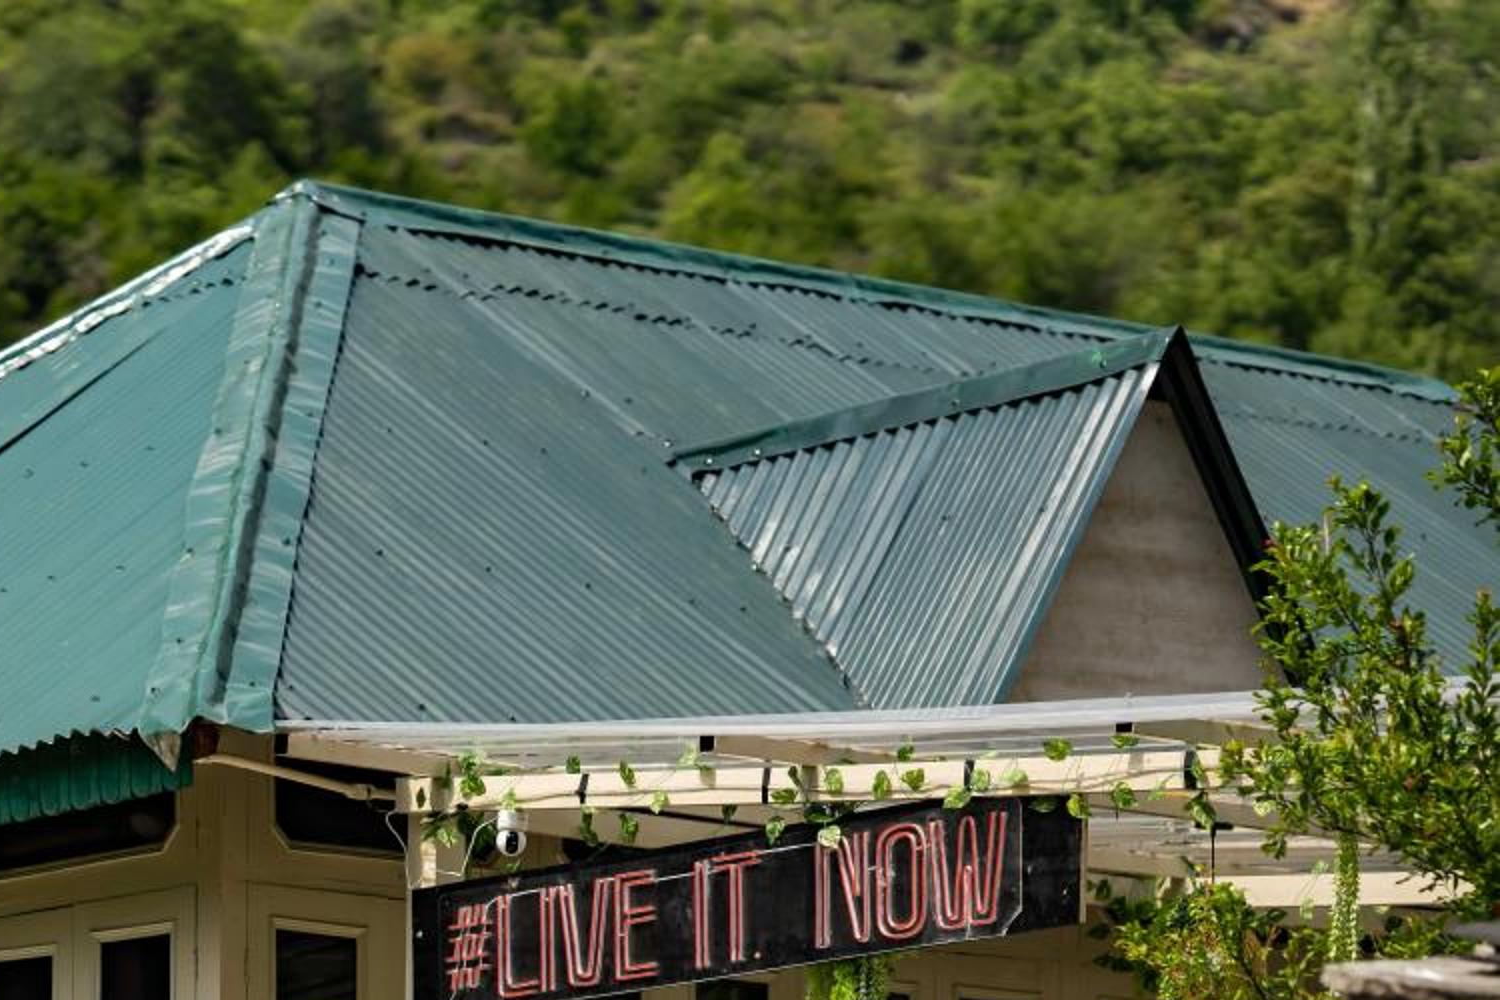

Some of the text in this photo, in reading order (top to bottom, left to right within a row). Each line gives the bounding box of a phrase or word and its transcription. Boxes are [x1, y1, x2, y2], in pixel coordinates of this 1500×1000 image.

[444, 810, 1008, 999] #LIVE IT NOW
